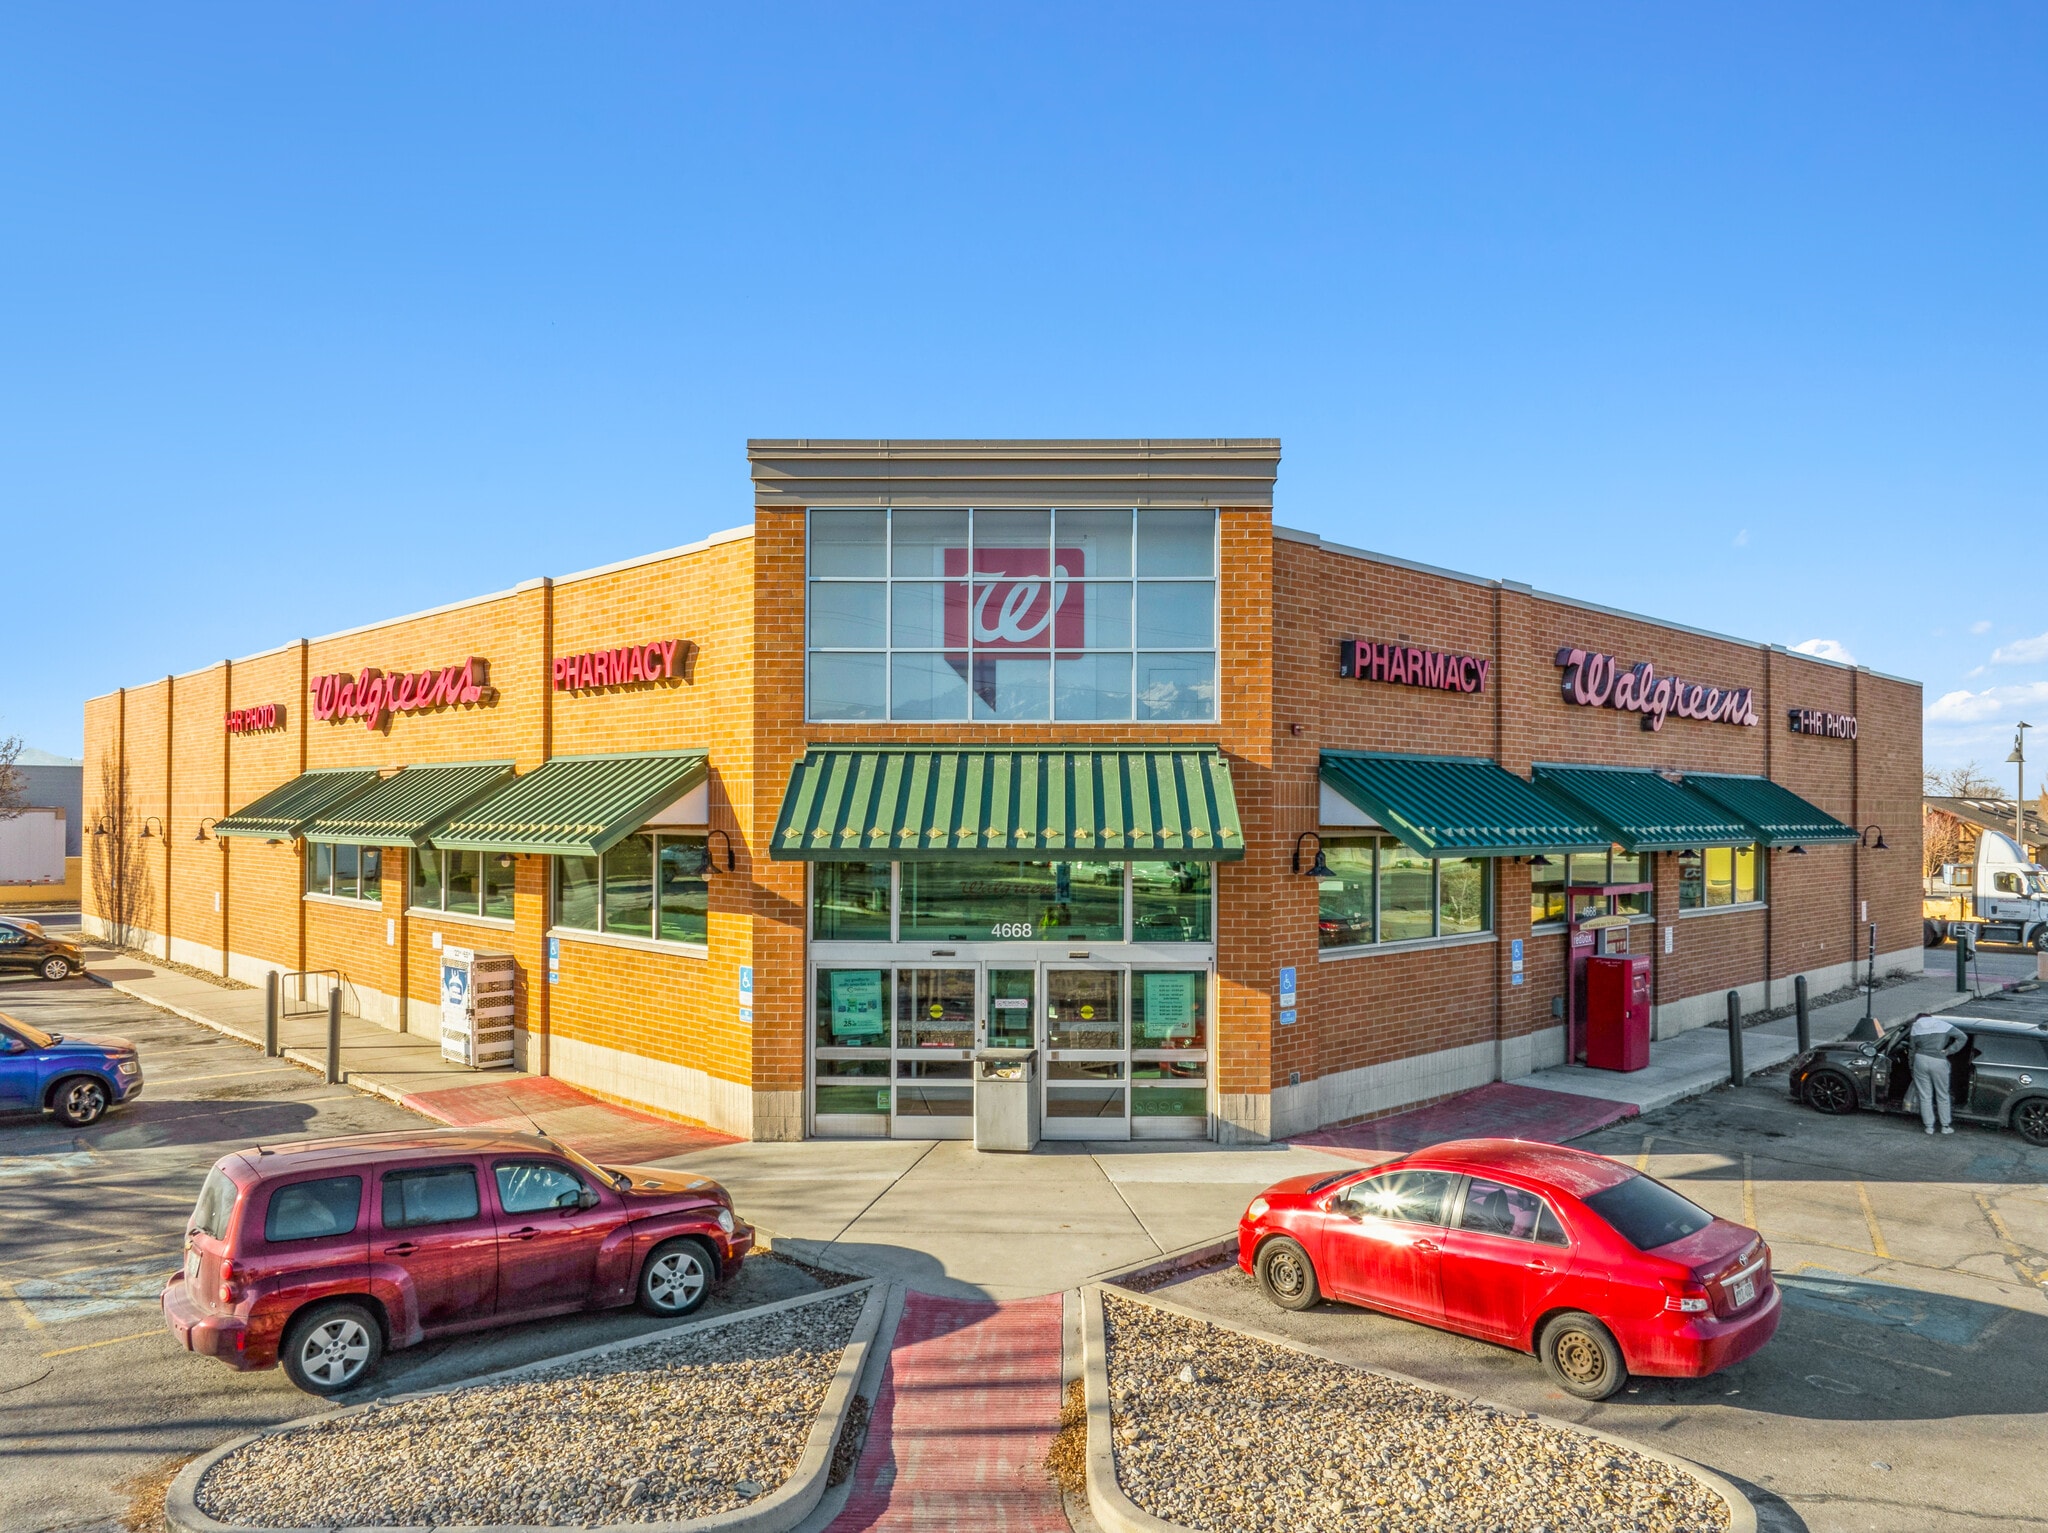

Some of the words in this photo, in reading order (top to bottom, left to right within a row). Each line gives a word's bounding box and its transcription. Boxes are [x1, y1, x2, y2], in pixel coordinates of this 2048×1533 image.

[553, 639, 677, 691] PHARMACY
[1354, 640, 1490, 693] PHARMACY
[310, 656, 482, 731] Walgreens
[1568, 649, 1759, 732] Walgreens
[224, 710, 243, 733] 1-HR
[245, 704, 276, 731] PHOTO
[1799, 709, 1823, 735] 1-HR
[1827, 713, 1858, 740] PHOTO
[991, 923, 1032, 938] 4668
[1582, 906, 1597, 917] 4668
